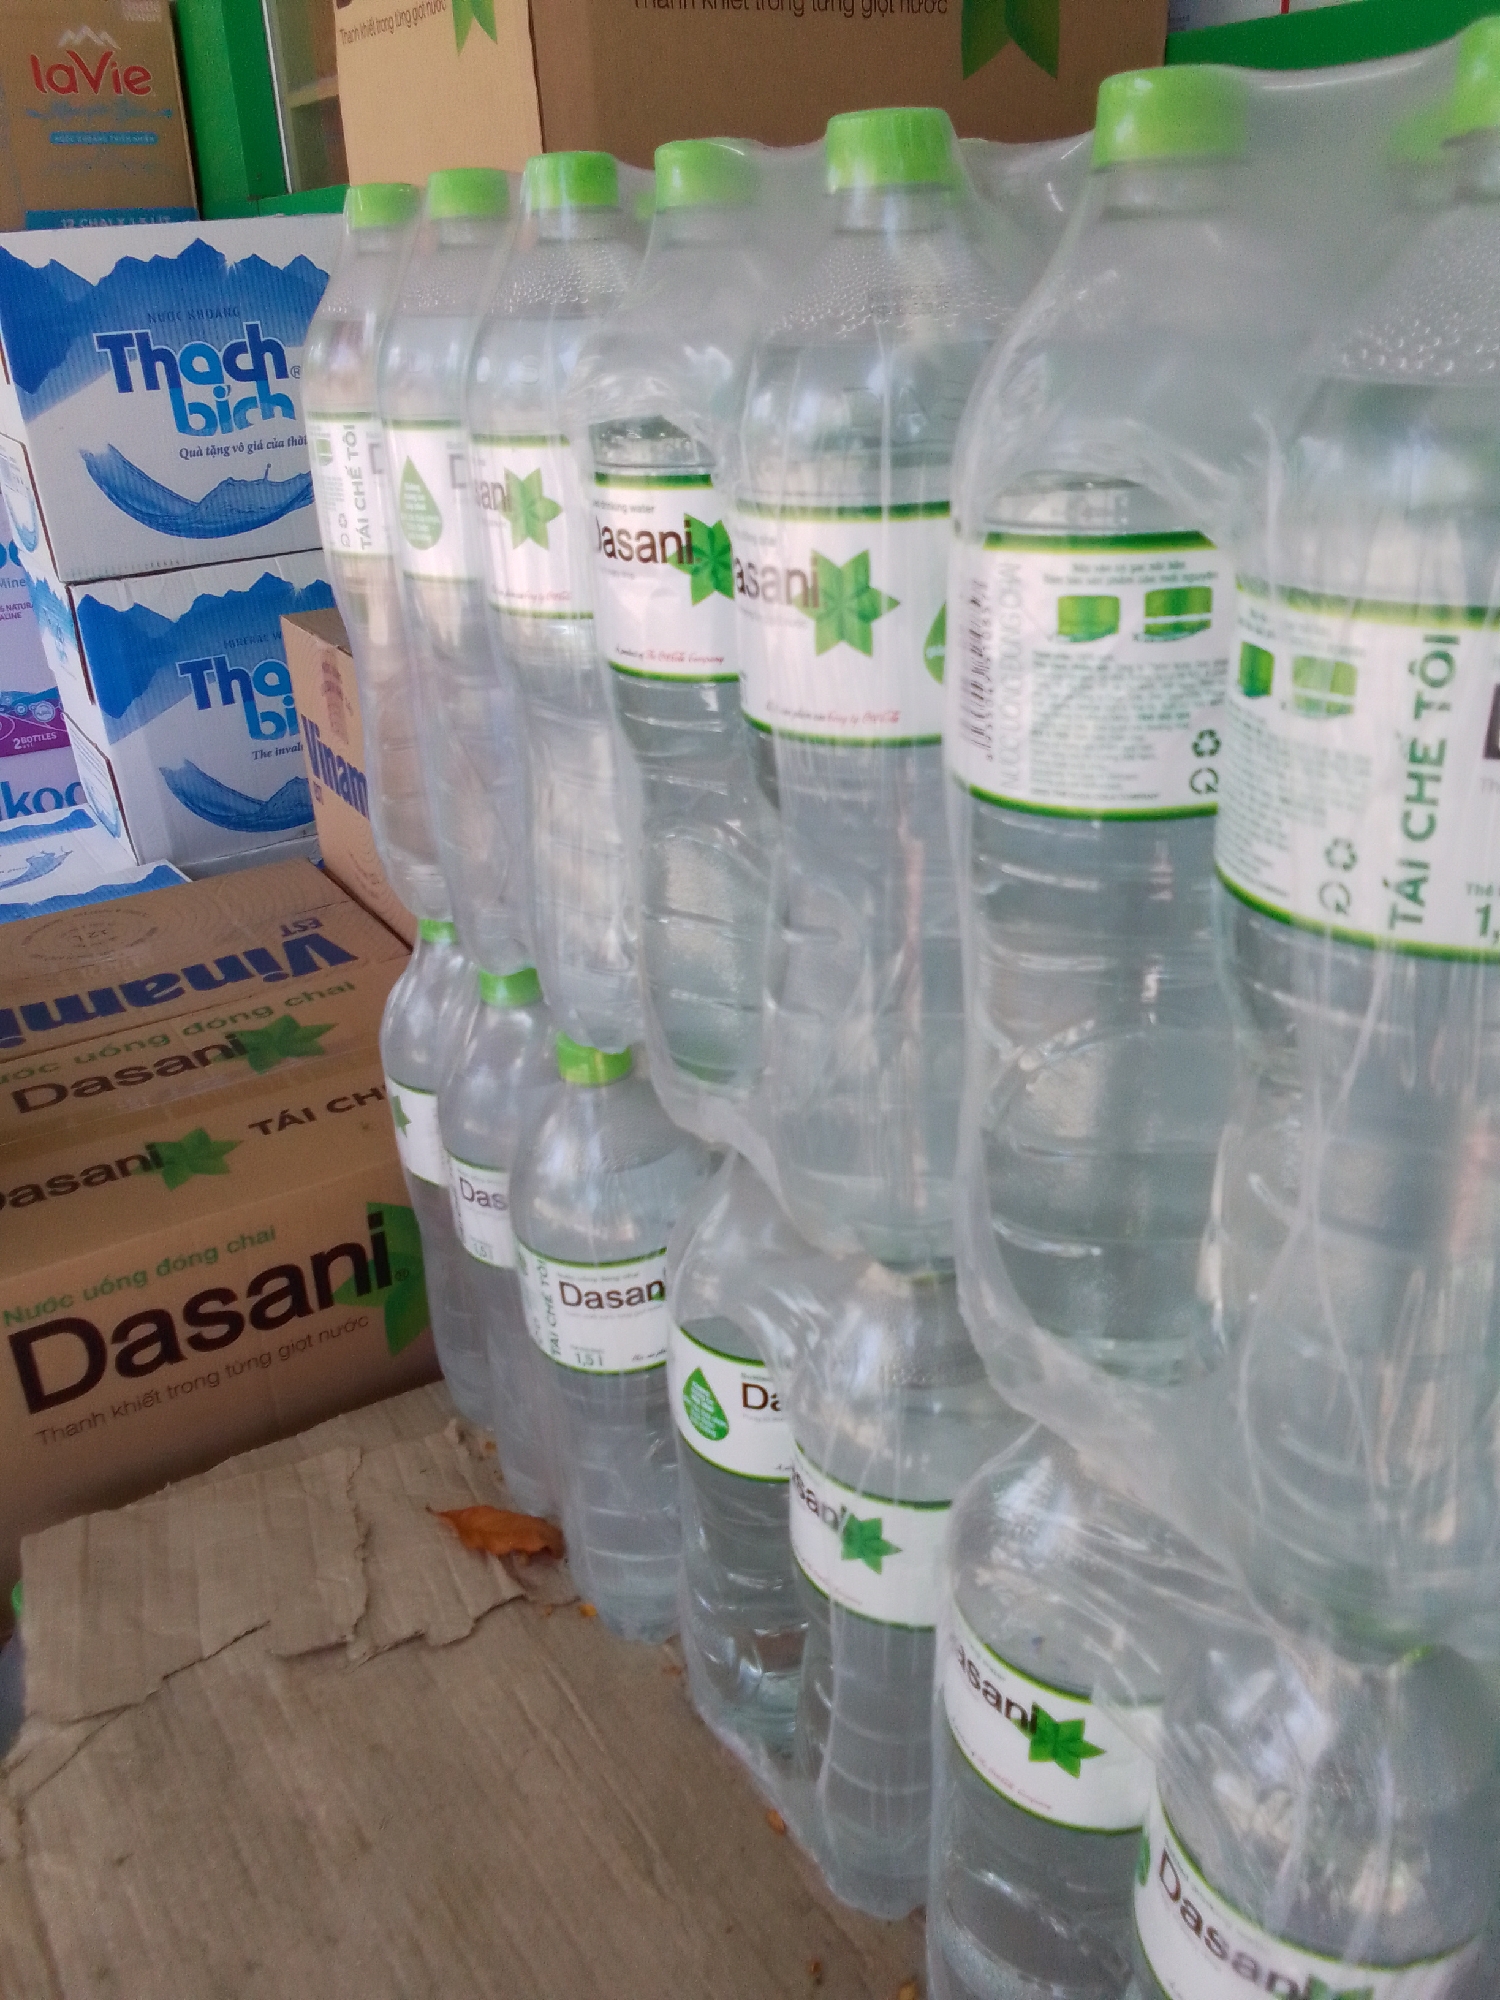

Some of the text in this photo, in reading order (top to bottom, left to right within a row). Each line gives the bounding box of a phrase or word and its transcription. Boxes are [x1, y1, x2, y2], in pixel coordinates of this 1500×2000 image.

[179, 444, 203, 461] Quà
[232, 441, 245, 454] vô
[247, 439, 264, 455] giá
[596, 517, 695, 566] asani
[0, 577, 27, 589] Mine
[6, 601, 34, 612] NATUR
[735, 556, 820, 609] asani
[0, 611, 22, 622] ALINE
[21, 731, 58, 744] BOTTLES
[275, 741, 304, 758] inval
[301, 713, 371, 820] Vinam
[1382, 857, 1431, 930] TÁI
[1408, 633, 1460, 720] TÔI
[281, 916, 325, 938] EST
[0, 933, 359, 1049] Vinami
[74, 1031, 172, 1064] uống
[182, 1003, 275, 1038] đóng
[284, 980, 357, 1008] chai
[11, 1031, 248, 1115] Dasani
[248, 1084, 389, 1138] TÁI CH
[0, 1142, 168, 1209] asani
[458, 1176, 510, 1212] Das
[3, 1225, 278, 1328] Nước uống đóng chai
[558, 1278, 667, 1310] Dasan
[7, 1210, 394, 1416] Dasani
[36, 1314, 371, 1447] Thanh khiết trong từng giọt nước
